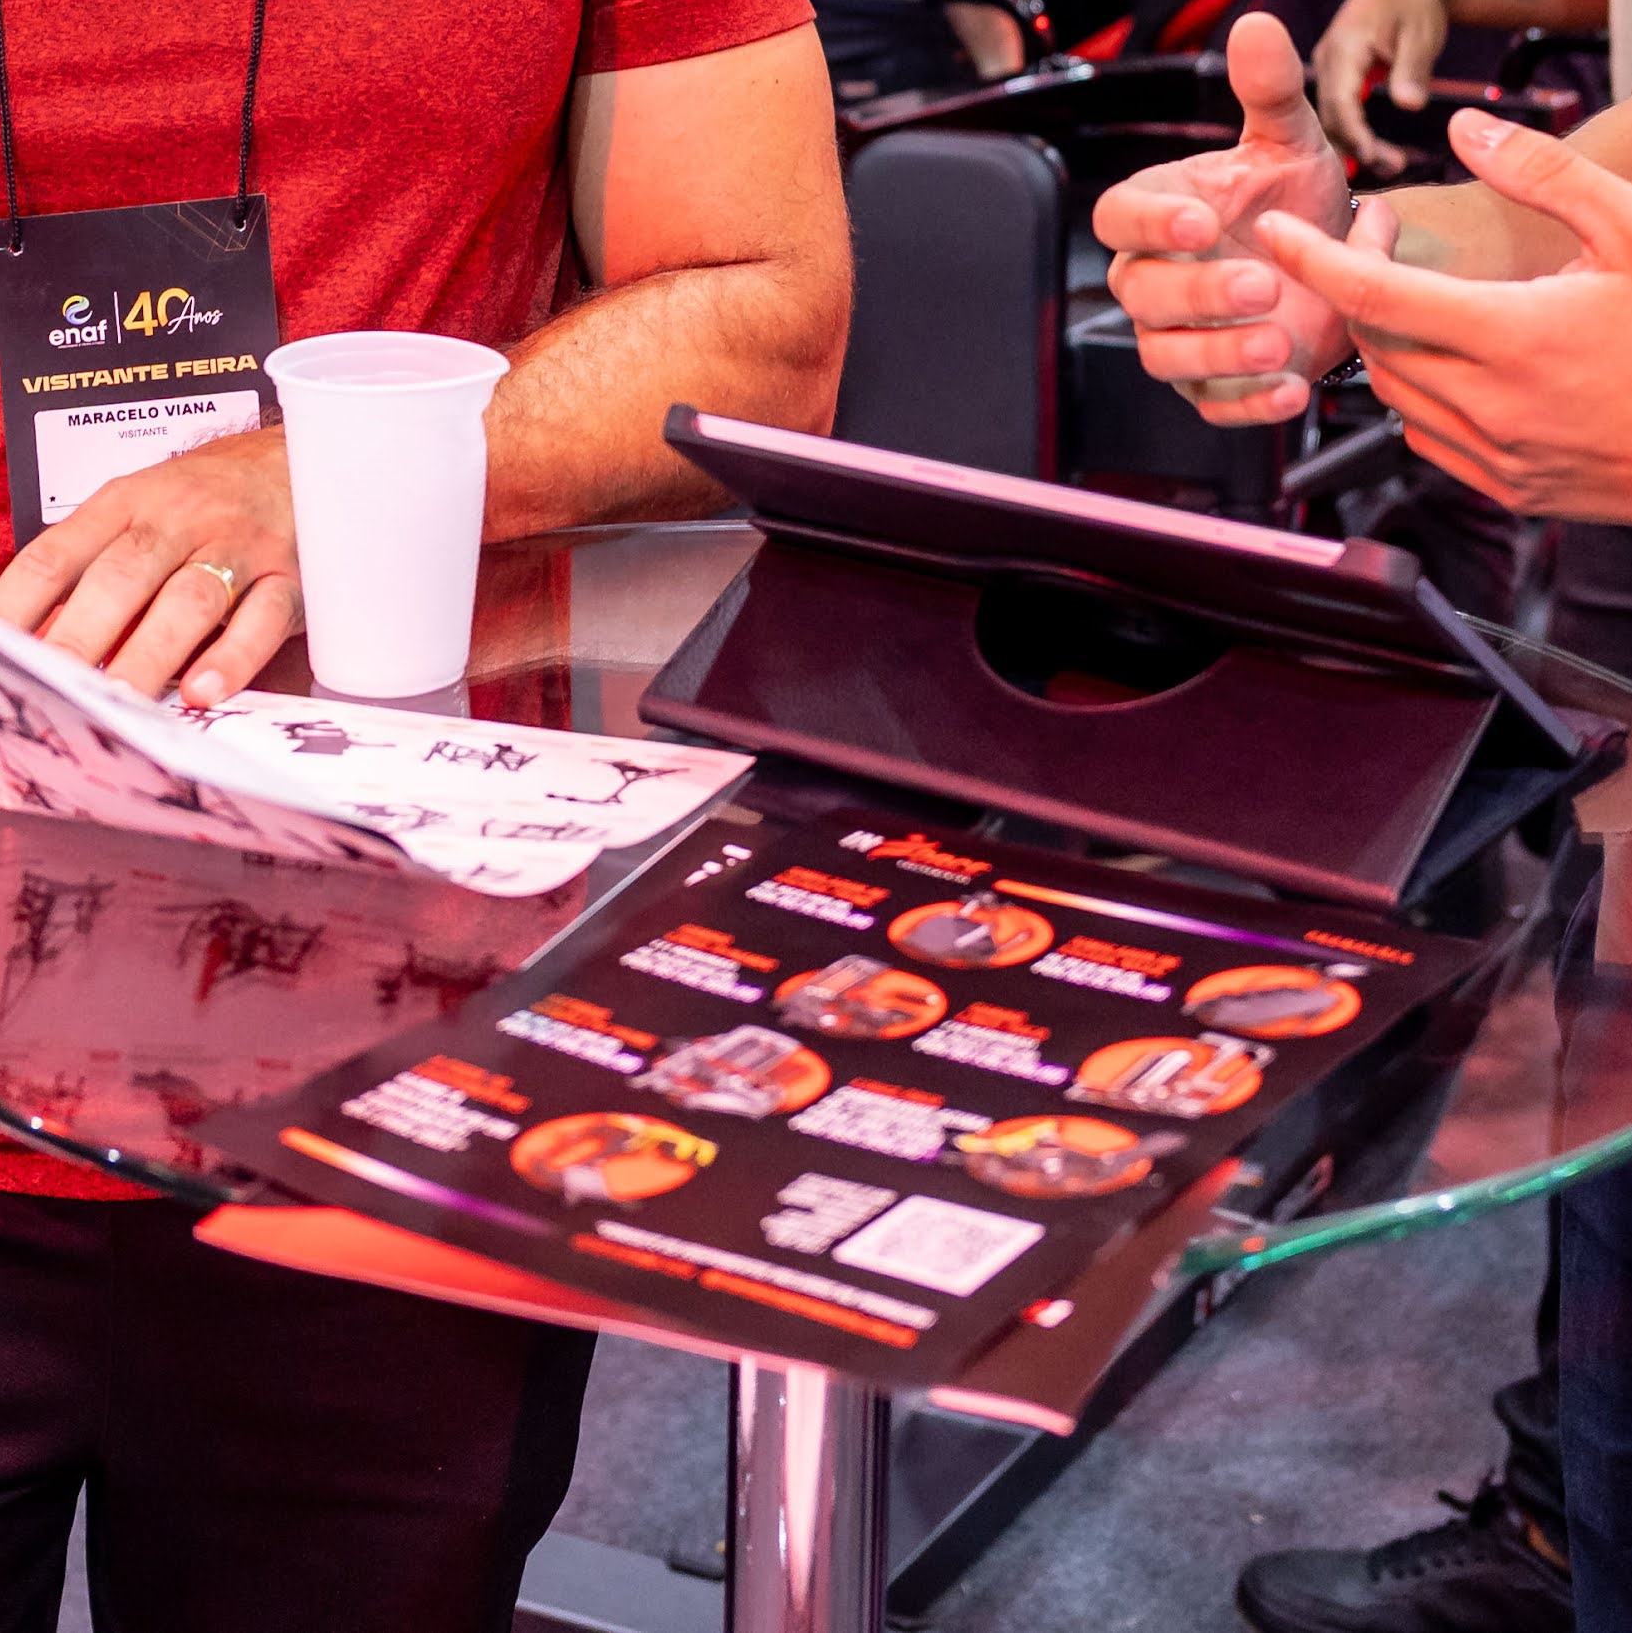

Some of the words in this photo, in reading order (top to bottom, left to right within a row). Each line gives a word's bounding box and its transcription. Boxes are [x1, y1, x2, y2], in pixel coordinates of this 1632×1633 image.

[48, 318, 109, 347] enaf
[167, 295, 224, 336] Anos
[21, 363, 169, 394] VISITANTE
[175, 354, 259, 379] FEIRA
[67, 406, 160, 427] MARACELO
[164, 400, 217, 416] VIANA
[117, 426, 169, 439] VISITANTE
